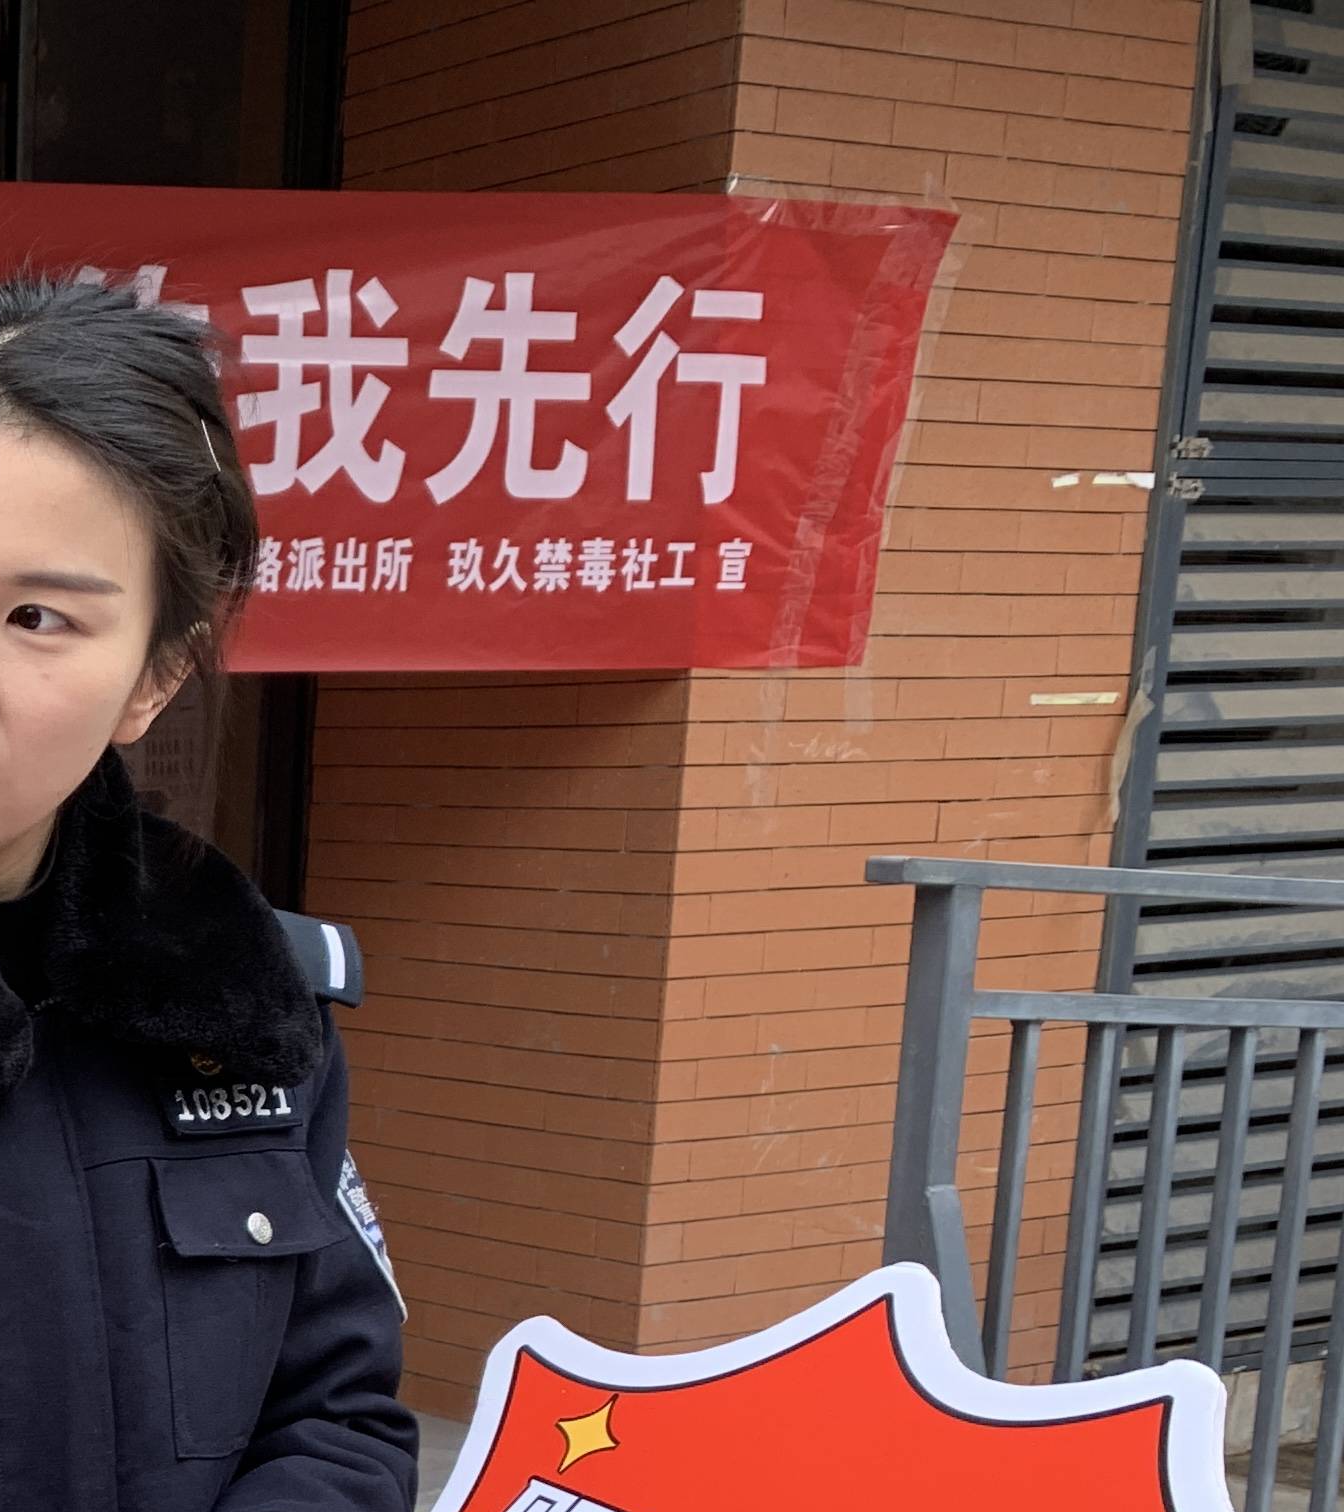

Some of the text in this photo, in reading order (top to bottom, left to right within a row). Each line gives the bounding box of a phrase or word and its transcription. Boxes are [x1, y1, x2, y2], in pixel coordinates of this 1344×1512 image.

[448, 537, 697, 592] 玖久禁毒社工
[717, 538, 753, 590] 宣
[175, 1084, 294, 1124] 108521
